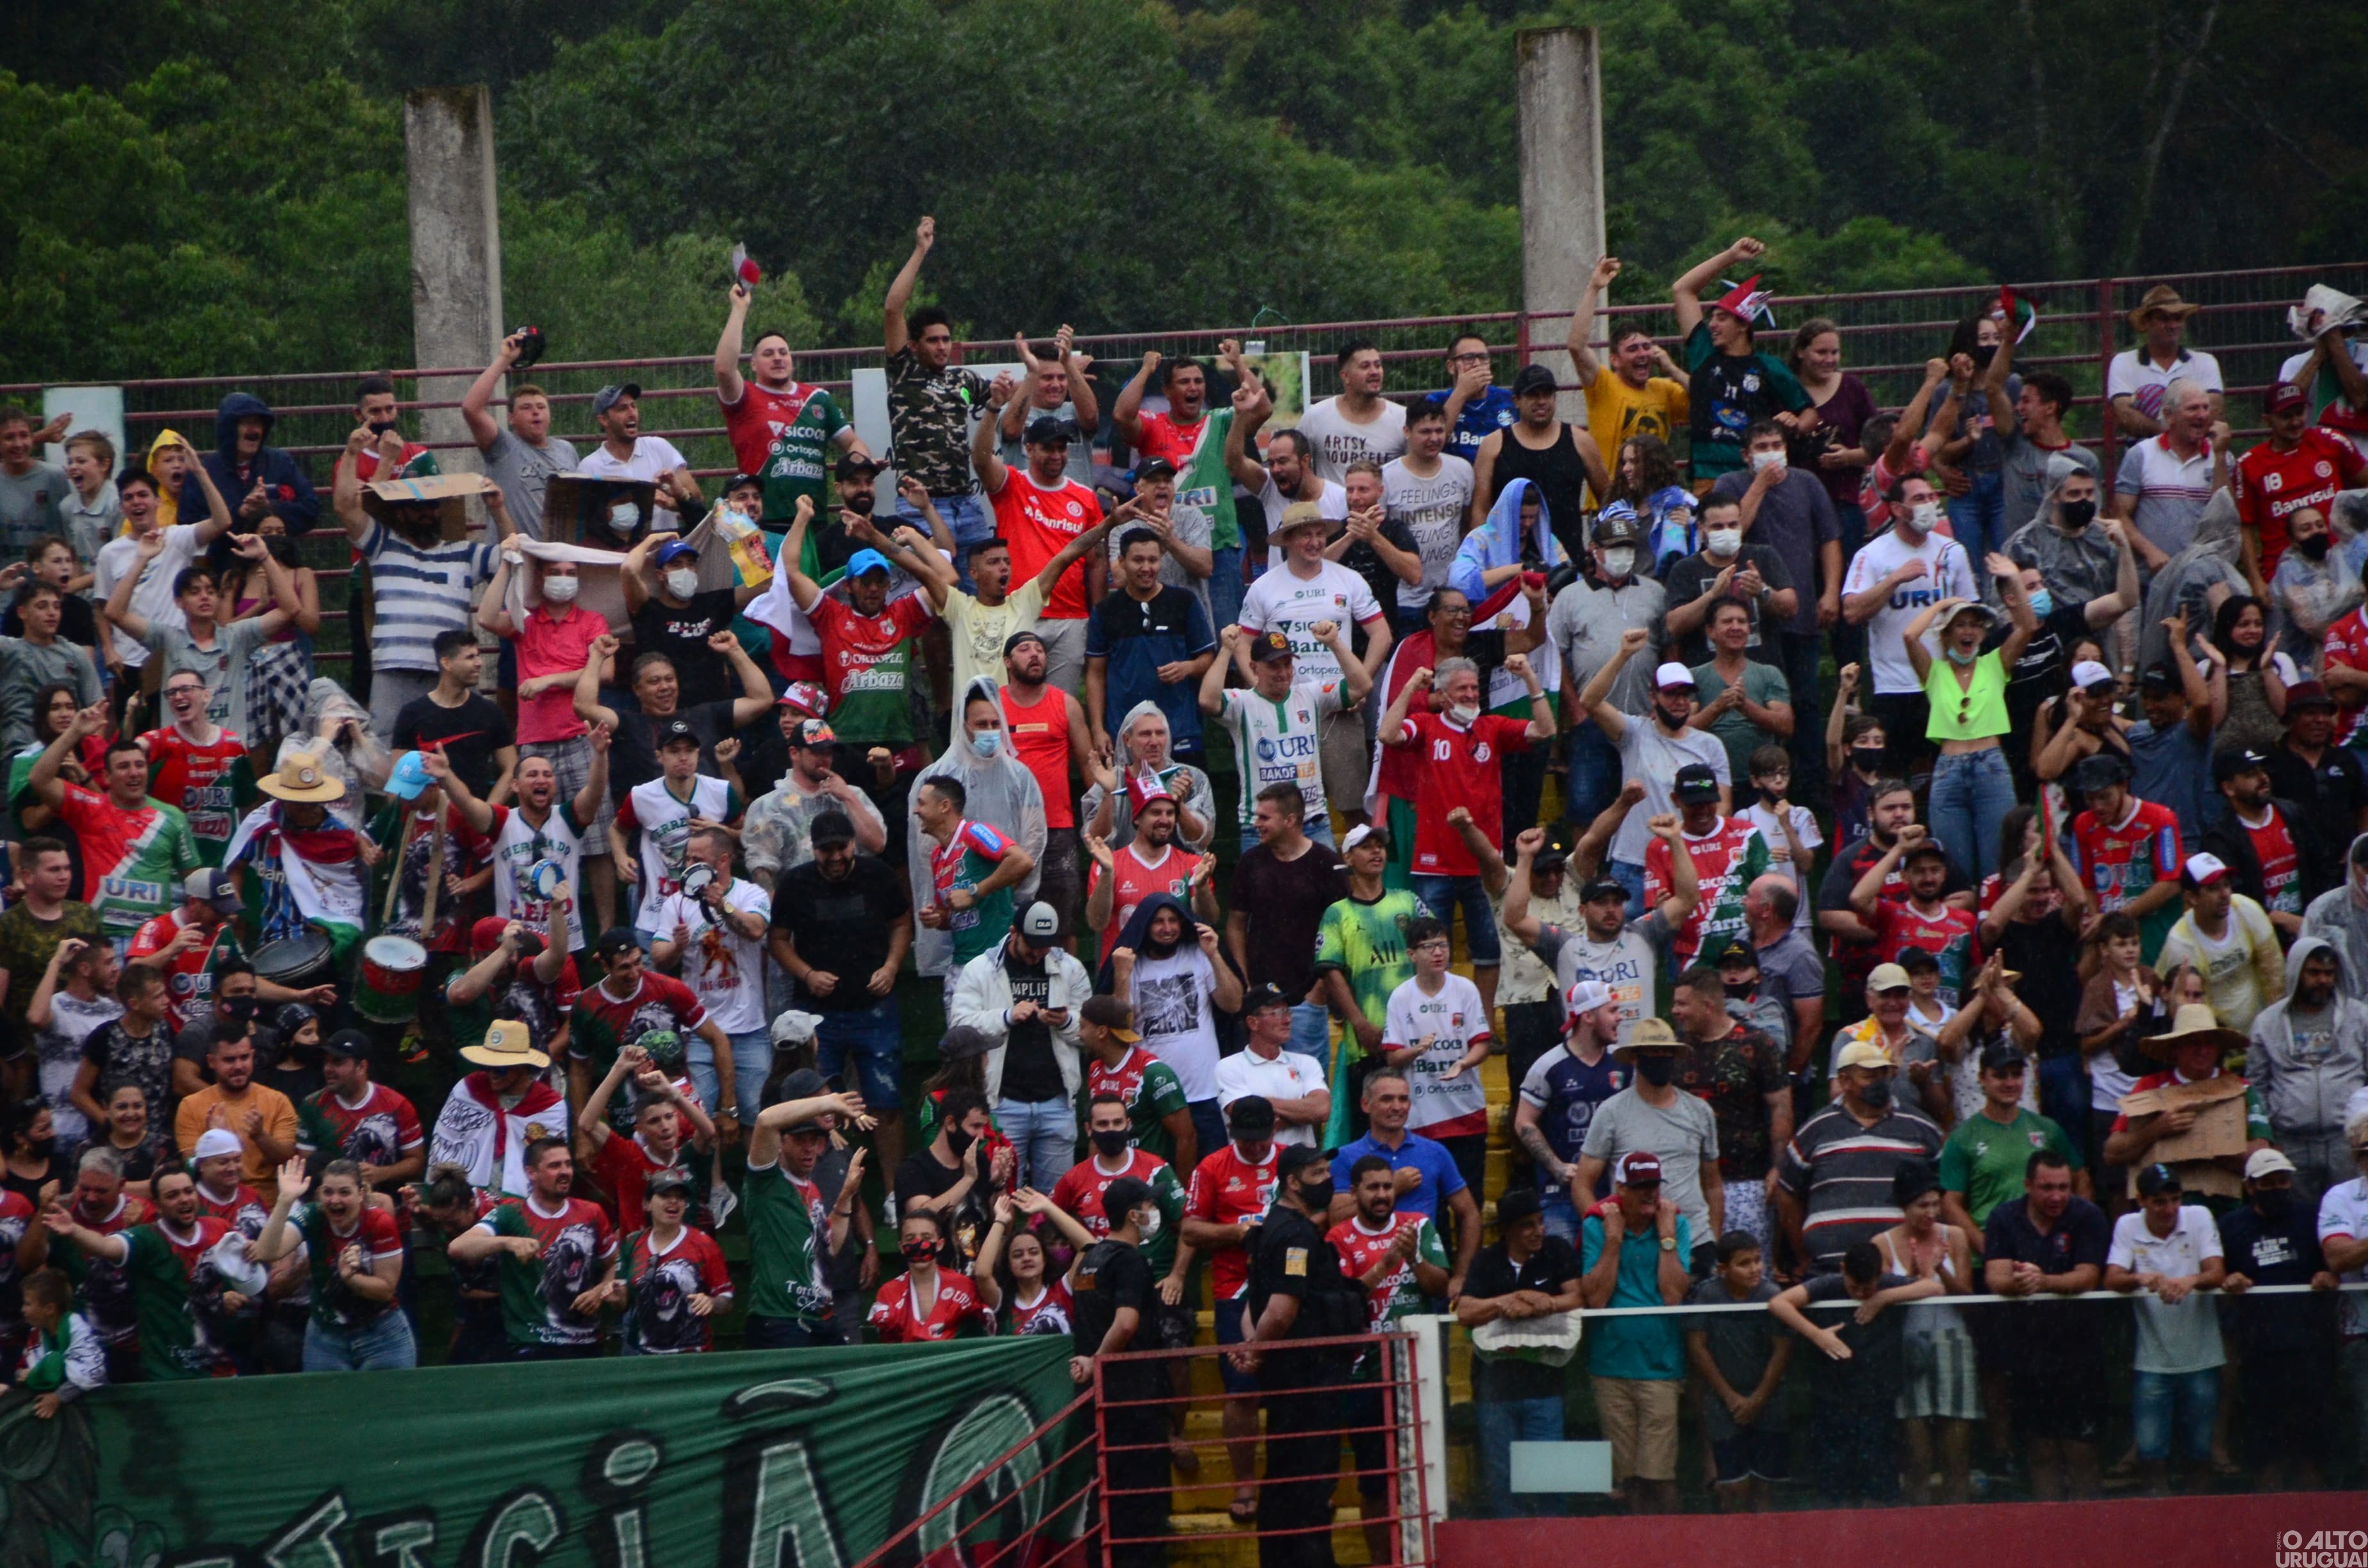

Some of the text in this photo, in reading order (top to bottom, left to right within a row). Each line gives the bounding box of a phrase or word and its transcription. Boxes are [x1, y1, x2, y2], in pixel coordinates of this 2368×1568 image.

[1324, 436, 1367, 450] ARTSY
[1400, 482, 1458, 504] FEELINGS
[2264, 473, 2282, 492] 18
[1033, 510, 1083, 534] Banrisul
[1290, 642, 1329, 653] Barr
[1276, 735, 1315, 758] URI
[1433, 739, 1451, 760] 10
[1260, 766, 1296, 780] BAKOF
[106, 878, 158, 901] URI
[1600, 960, 1640, 983] URI
[1012, 982, 1048, 997] MPLIF
